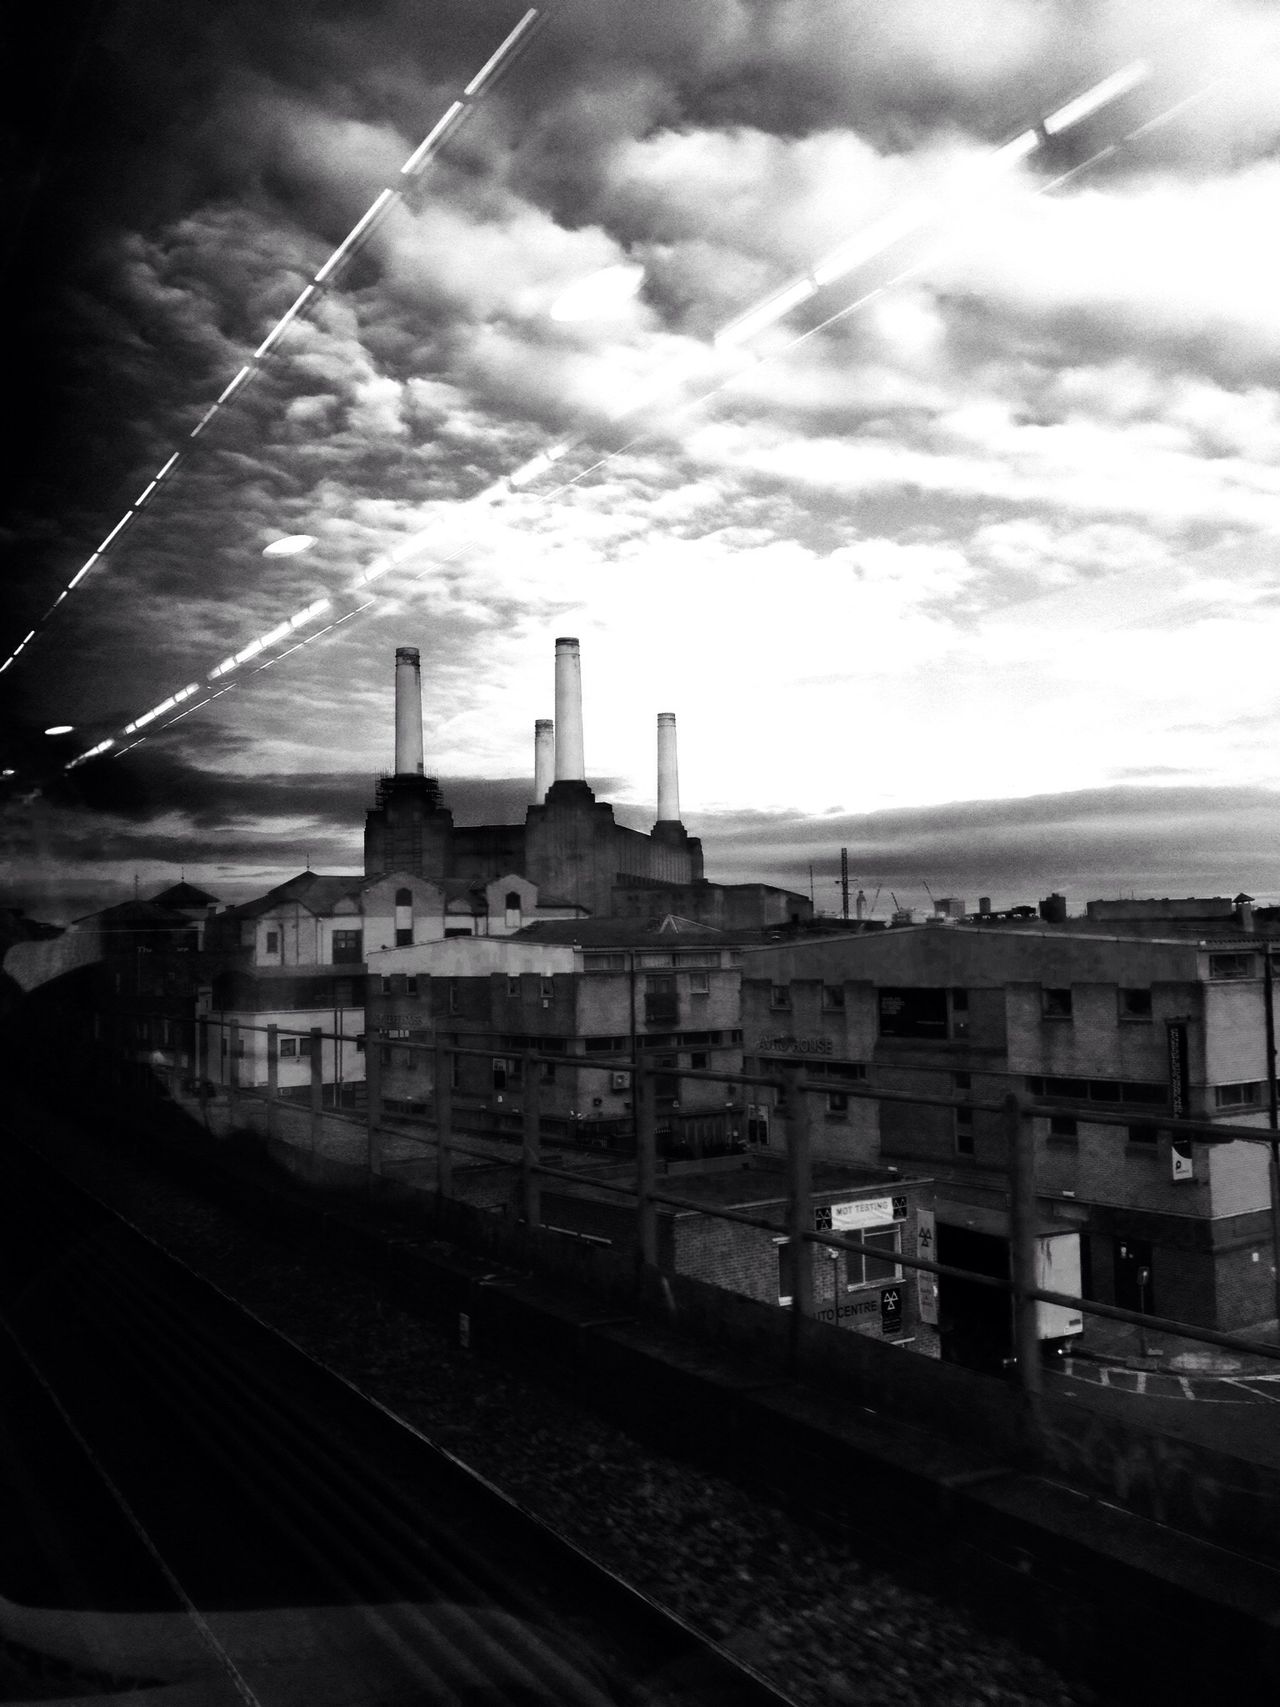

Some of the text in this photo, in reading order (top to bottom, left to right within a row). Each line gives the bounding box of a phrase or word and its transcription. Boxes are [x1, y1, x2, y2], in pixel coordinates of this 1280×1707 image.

[792, 1038, 833, 1055] HOUSE
[836, 1201, 889, 1216] MOT TESTING
[812, 1300, 878, 1320] UTO CENTRE
